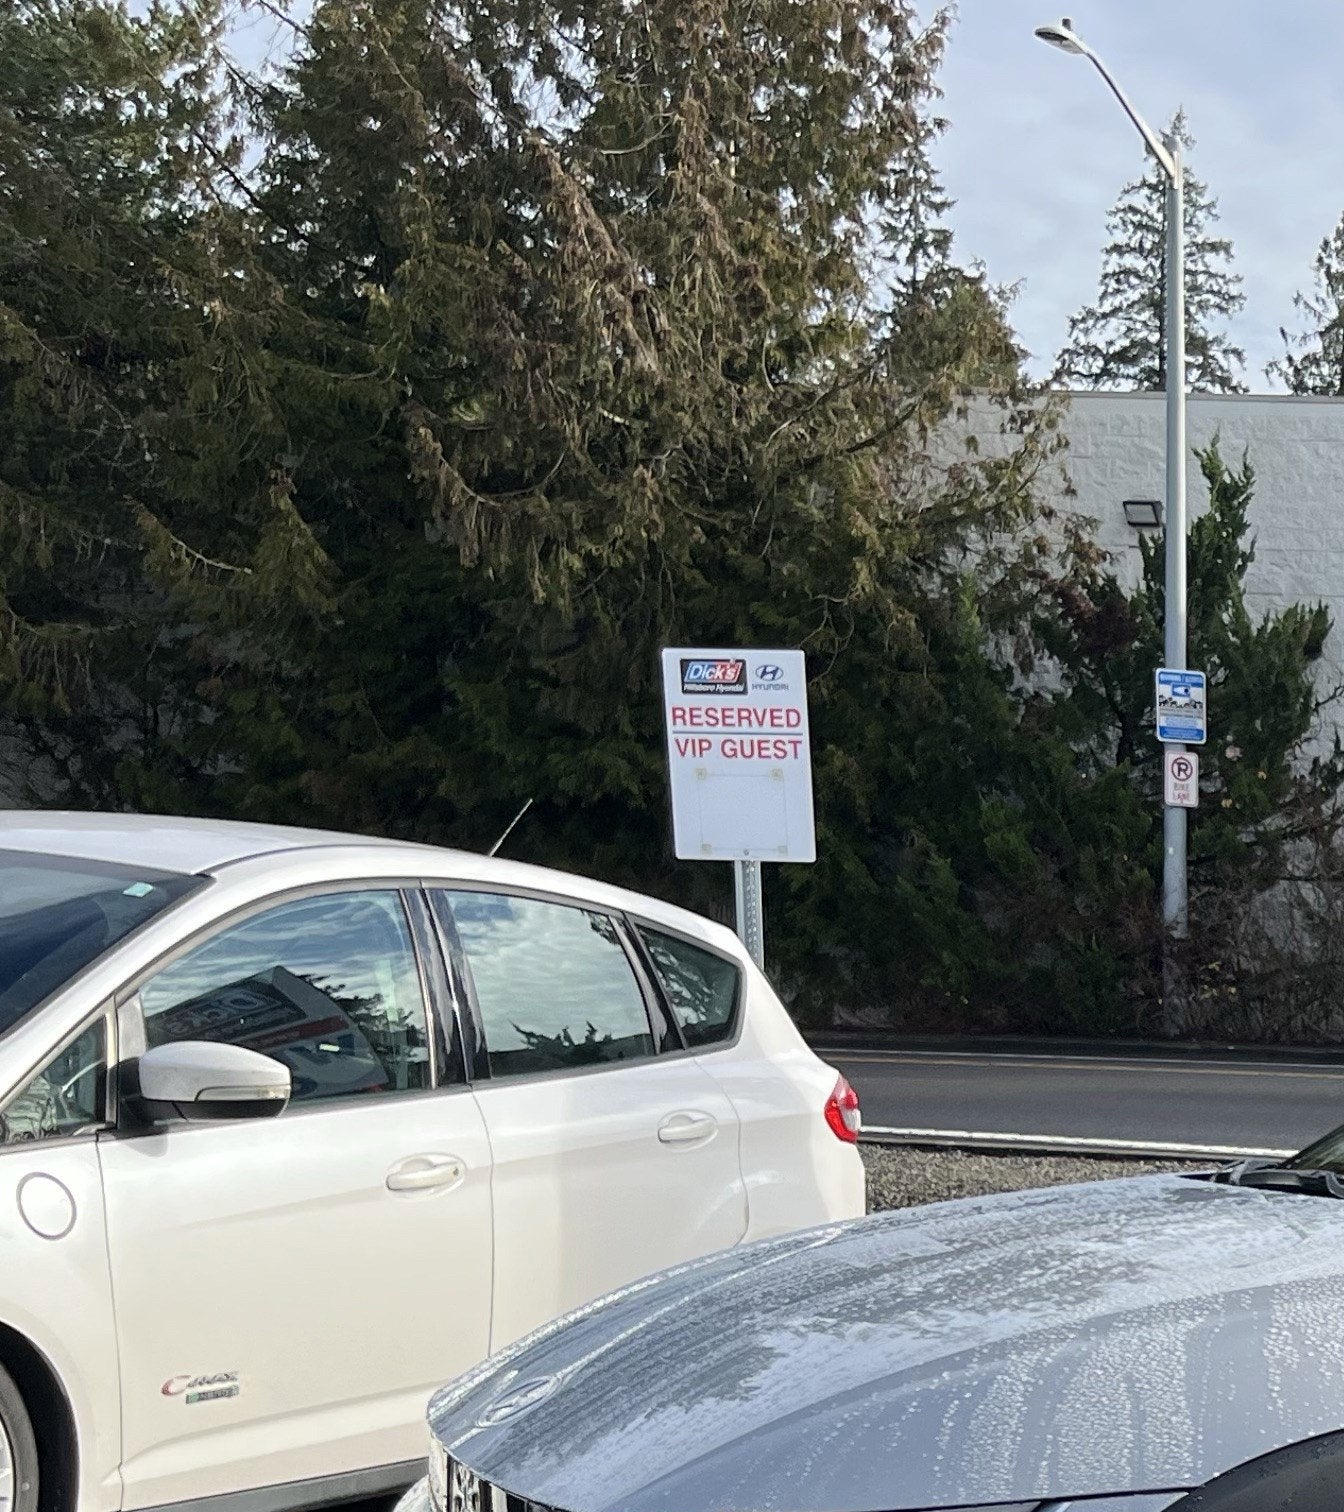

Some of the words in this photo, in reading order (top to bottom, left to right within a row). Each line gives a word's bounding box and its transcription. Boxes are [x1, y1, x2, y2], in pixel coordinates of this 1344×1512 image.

[672, 707, 801, 728] RESERVED
[674, 738, 713, 758] VIP
[720, 739, 803, 760] GUEST
